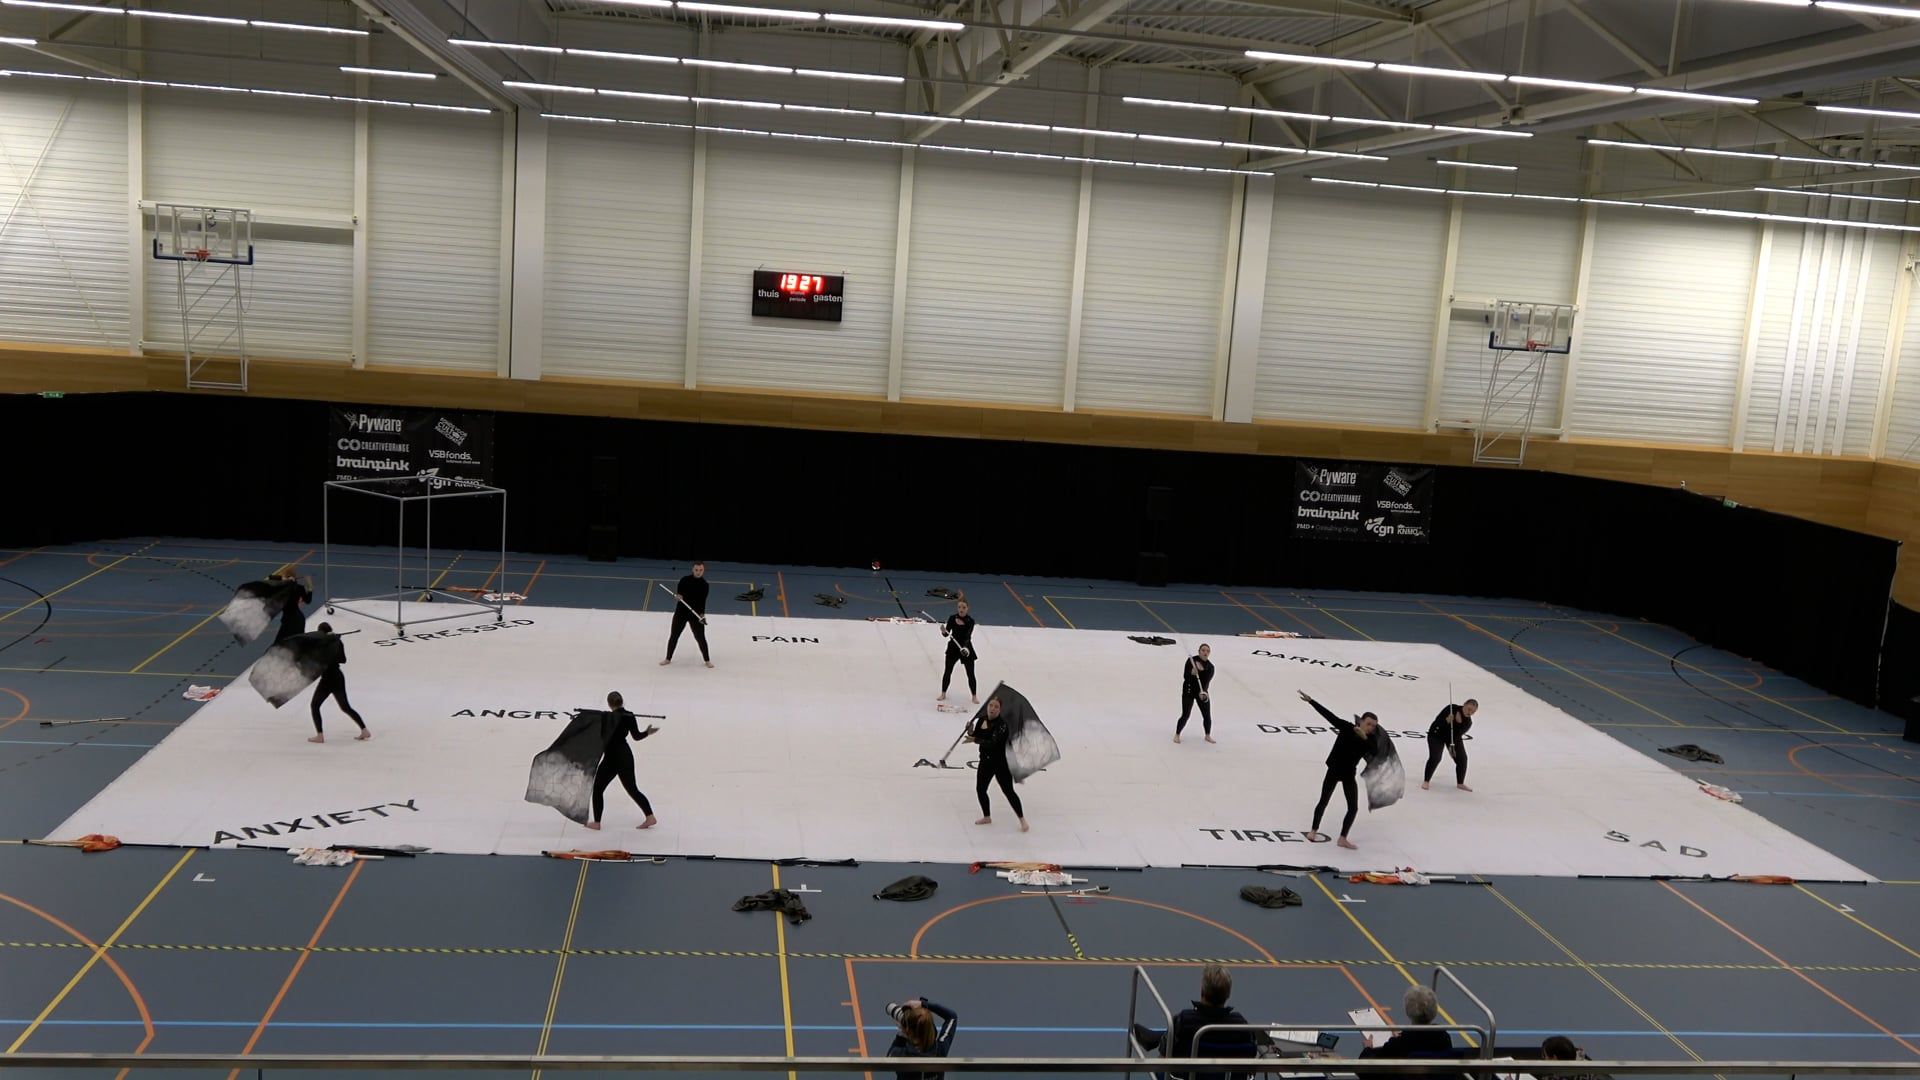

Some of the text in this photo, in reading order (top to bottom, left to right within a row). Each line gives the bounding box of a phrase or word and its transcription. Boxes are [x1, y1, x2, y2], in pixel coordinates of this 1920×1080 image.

[758, 289, 780, 298] thuis
[813, 294, 843, 302] gasten
[358, 413, 402, 433] Pyware
[336, 455, 410, 472] brainpink
[1319, 469, 1357, 486] Pyware
[1297, 506, 1360, 520] brainpink
[1373, 525, 1394, 537] cgn
[373, 619, 535, 647] STRESSED
[752, 635, 819, 643] PAIN
[1251, 650, 1419, 681] DARKNESS
[451, 709, 581, 720] ANGRY
[213, 799, 419, 845] ANXIETY
[1198, 828, 1332, 843] TIRED
[1603, 830, 1708, 858] SAD
